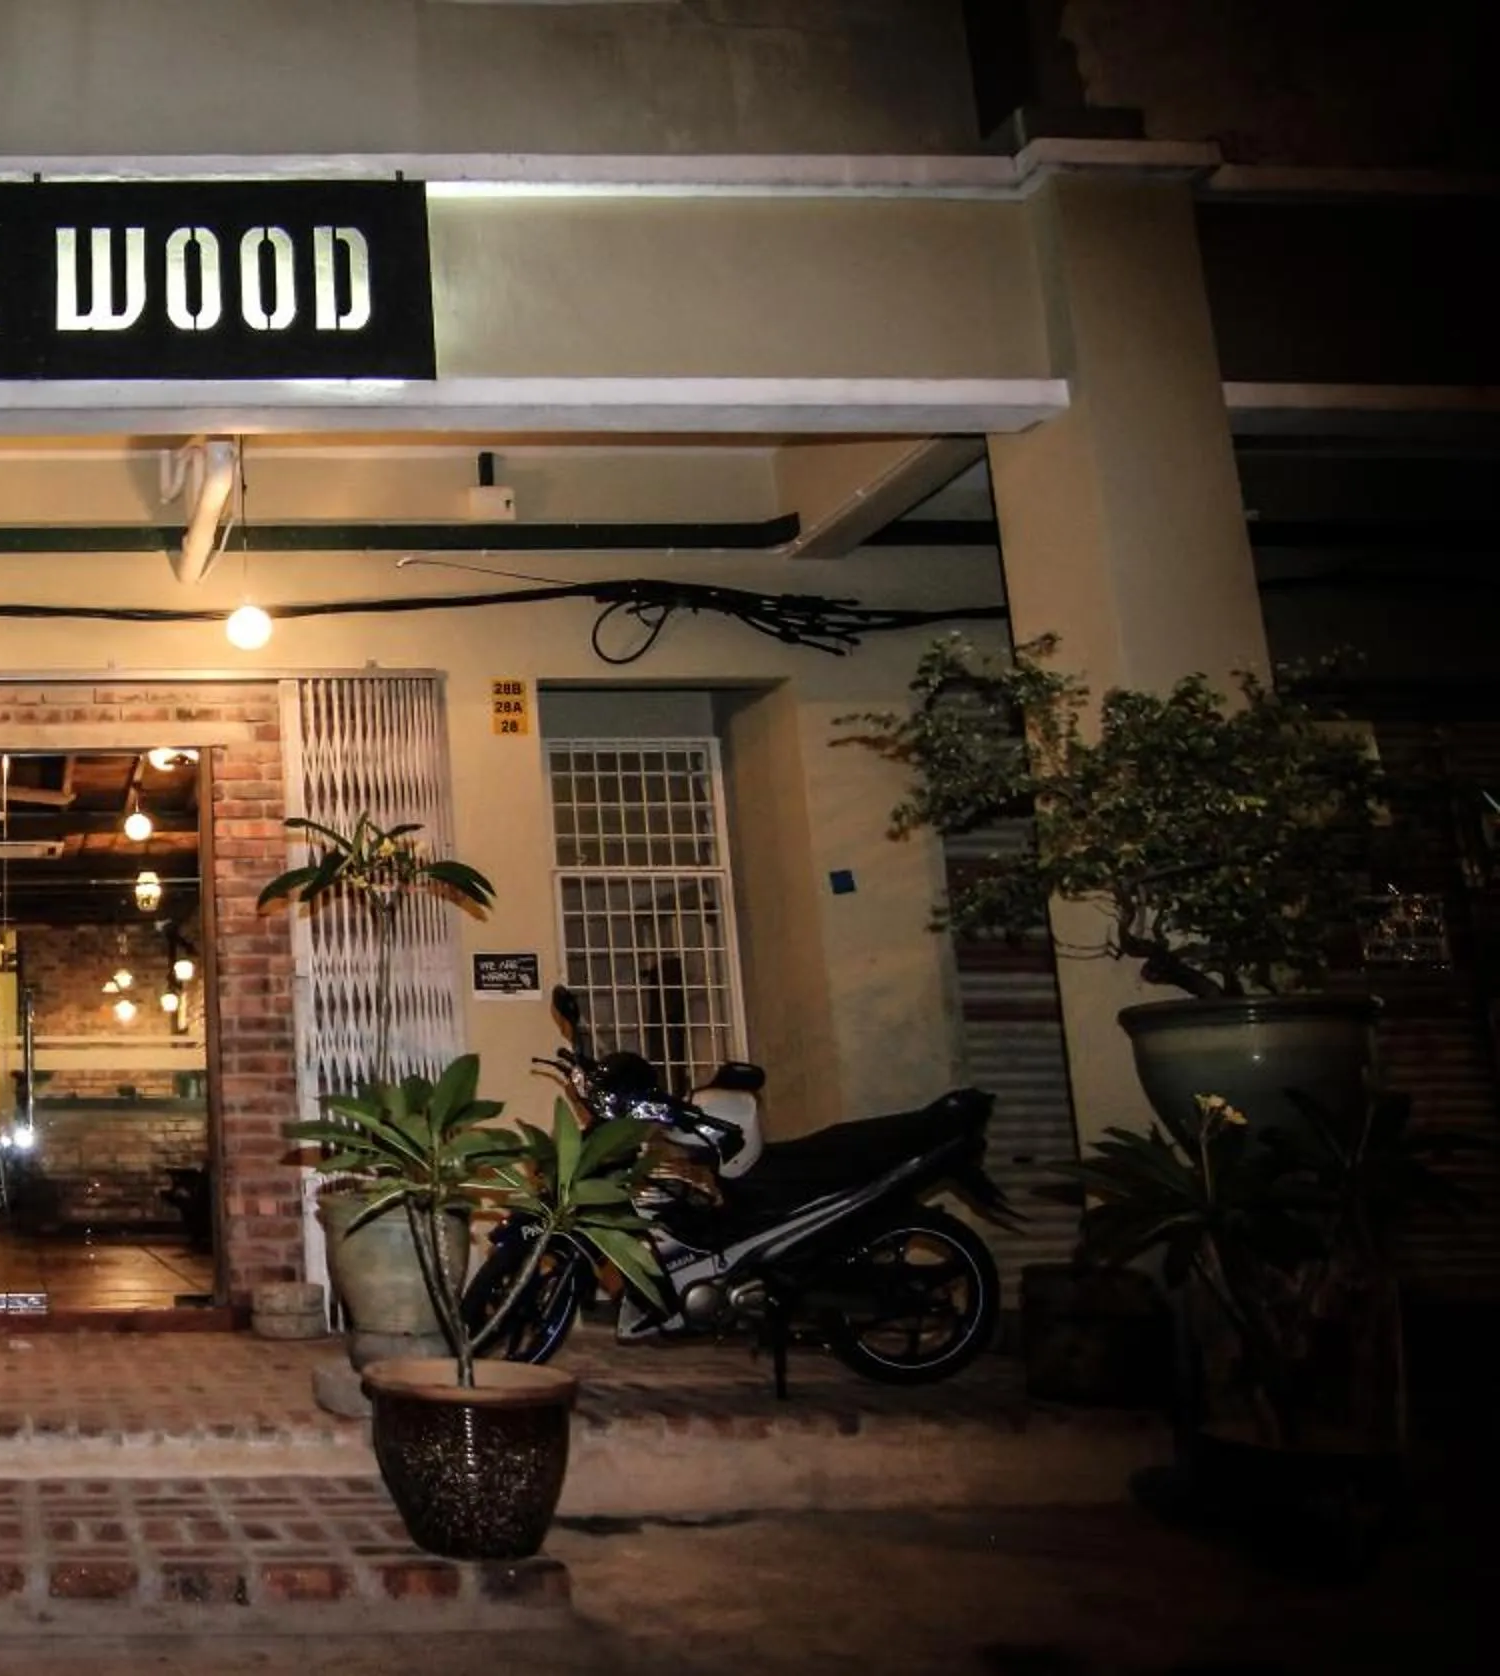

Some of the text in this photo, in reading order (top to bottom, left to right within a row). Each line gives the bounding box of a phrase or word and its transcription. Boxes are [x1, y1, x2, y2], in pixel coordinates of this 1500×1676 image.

[55, 226, 372, 331] WOOD
[494, 701, 523, 713] 28A
[501, 719, 519, 733] 28
